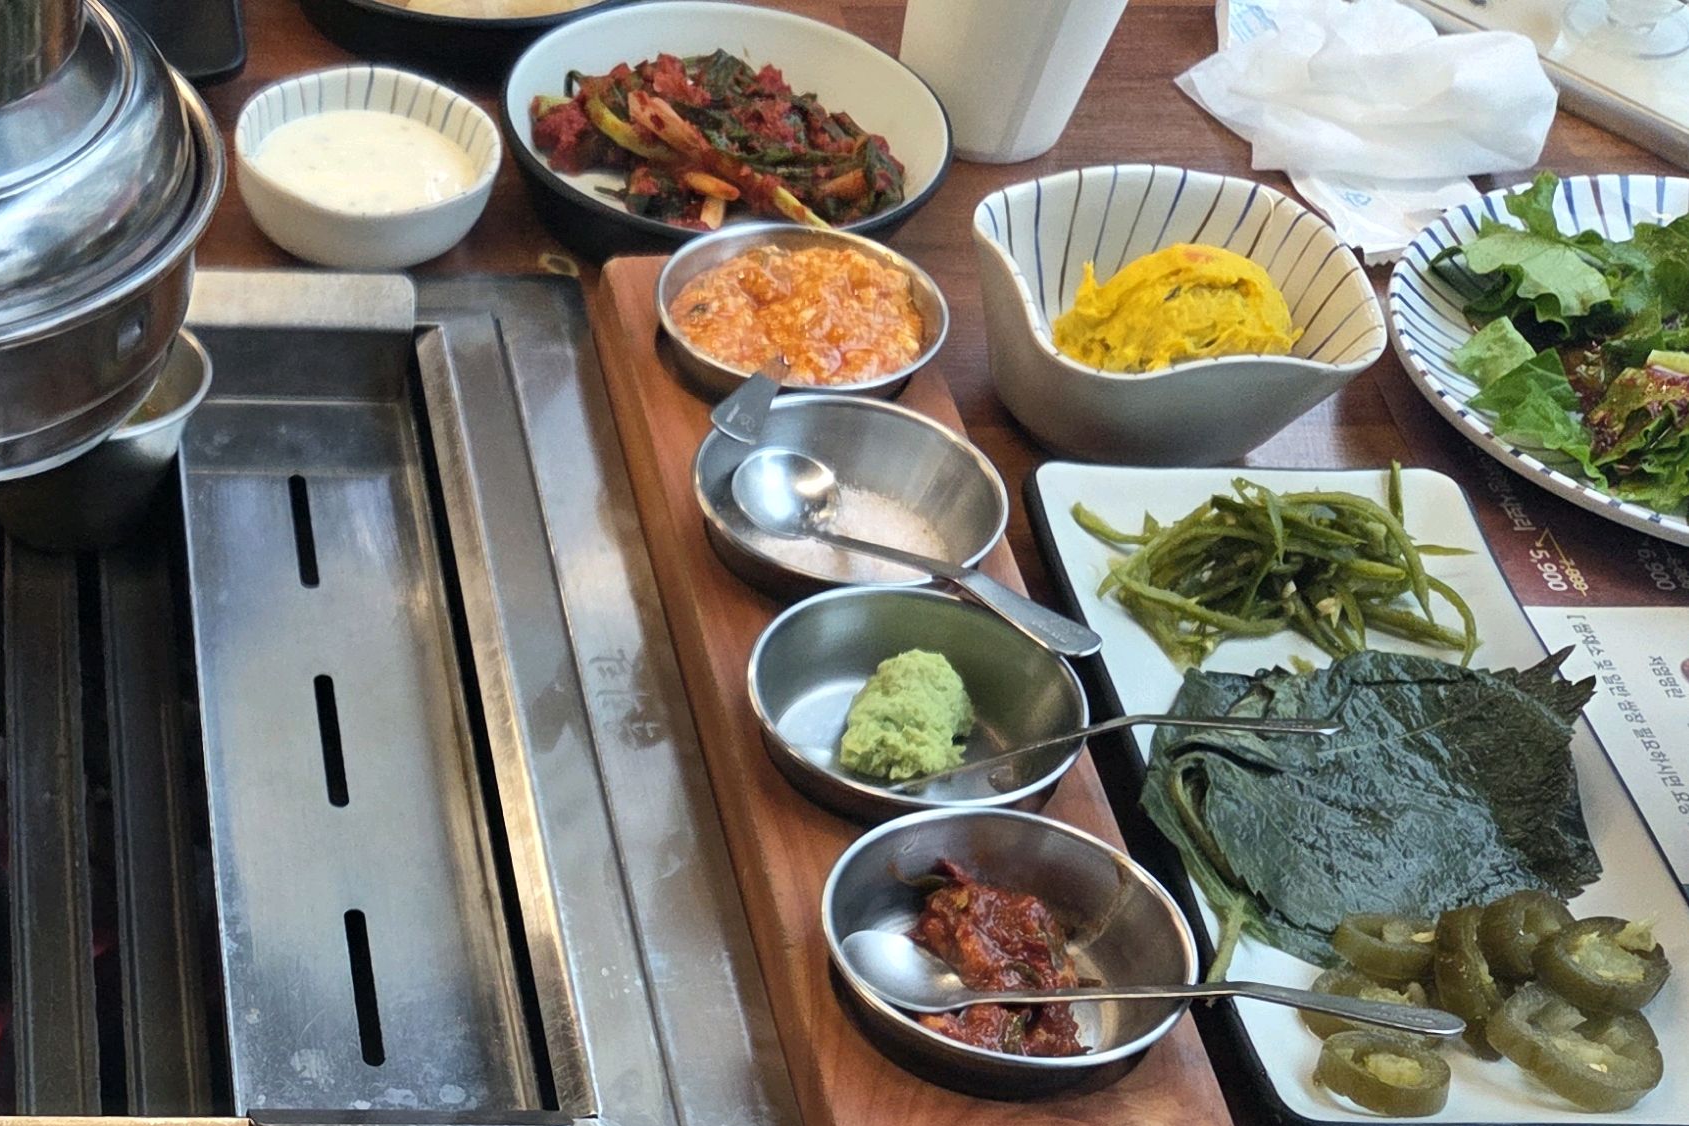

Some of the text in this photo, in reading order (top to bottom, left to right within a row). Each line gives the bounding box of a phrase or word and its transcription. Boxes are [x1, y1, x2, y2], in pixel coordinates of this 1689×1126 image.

[1529, 549, 1568, 592] 5,900
[1572, 622, 1605, 657] 쌈채소
[1593, 659, 1617, 670] 및
[1649, 656, 1686, 699] 저염명란
[1602, 674, 1631, 697] 일반
[1618, 700, 1646, 723] 쌈장
[1633, 727, 1685, 787] 필요하시면
